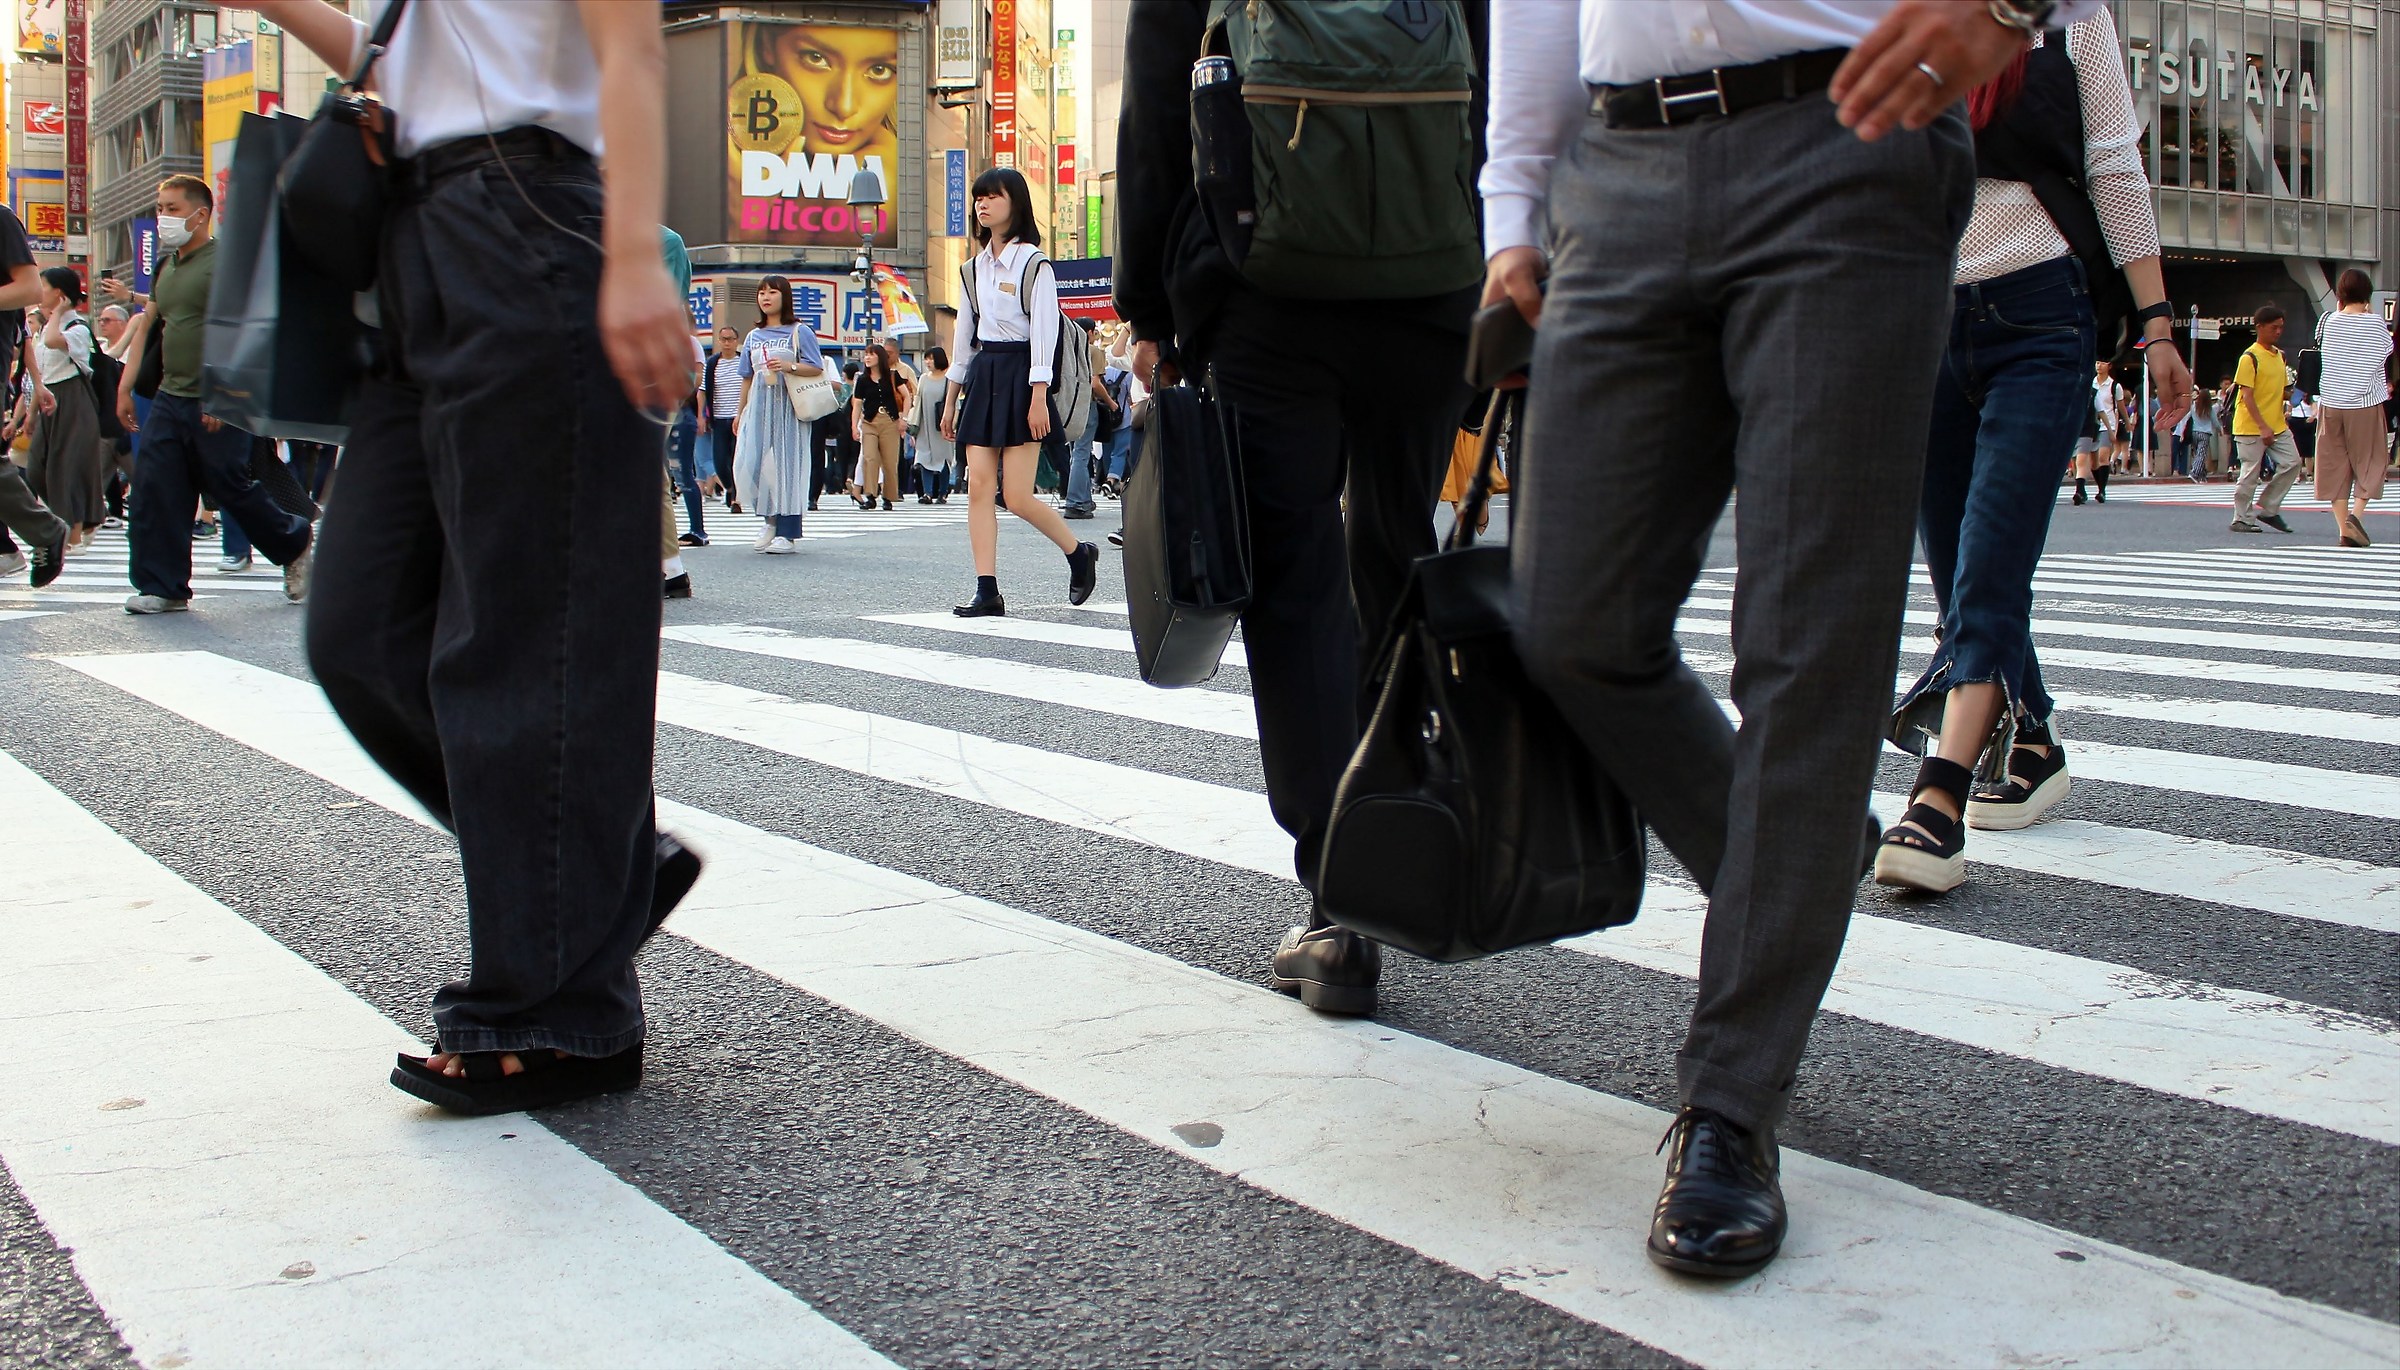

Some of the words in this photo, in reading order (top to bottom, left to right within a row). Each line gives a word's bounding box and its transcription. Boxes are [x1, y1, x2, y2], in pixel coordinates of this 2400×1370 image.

[2127, 50, 2318, 112] TSUTAYA
[741, 150, 888, 200] DMM
[141, 230, 153, 276] MIZUHO
[1060, 301, 1083, 310] Welcome
[1085, 301, 1090, 309] to
[796, 384, 813, 394] DEAN
